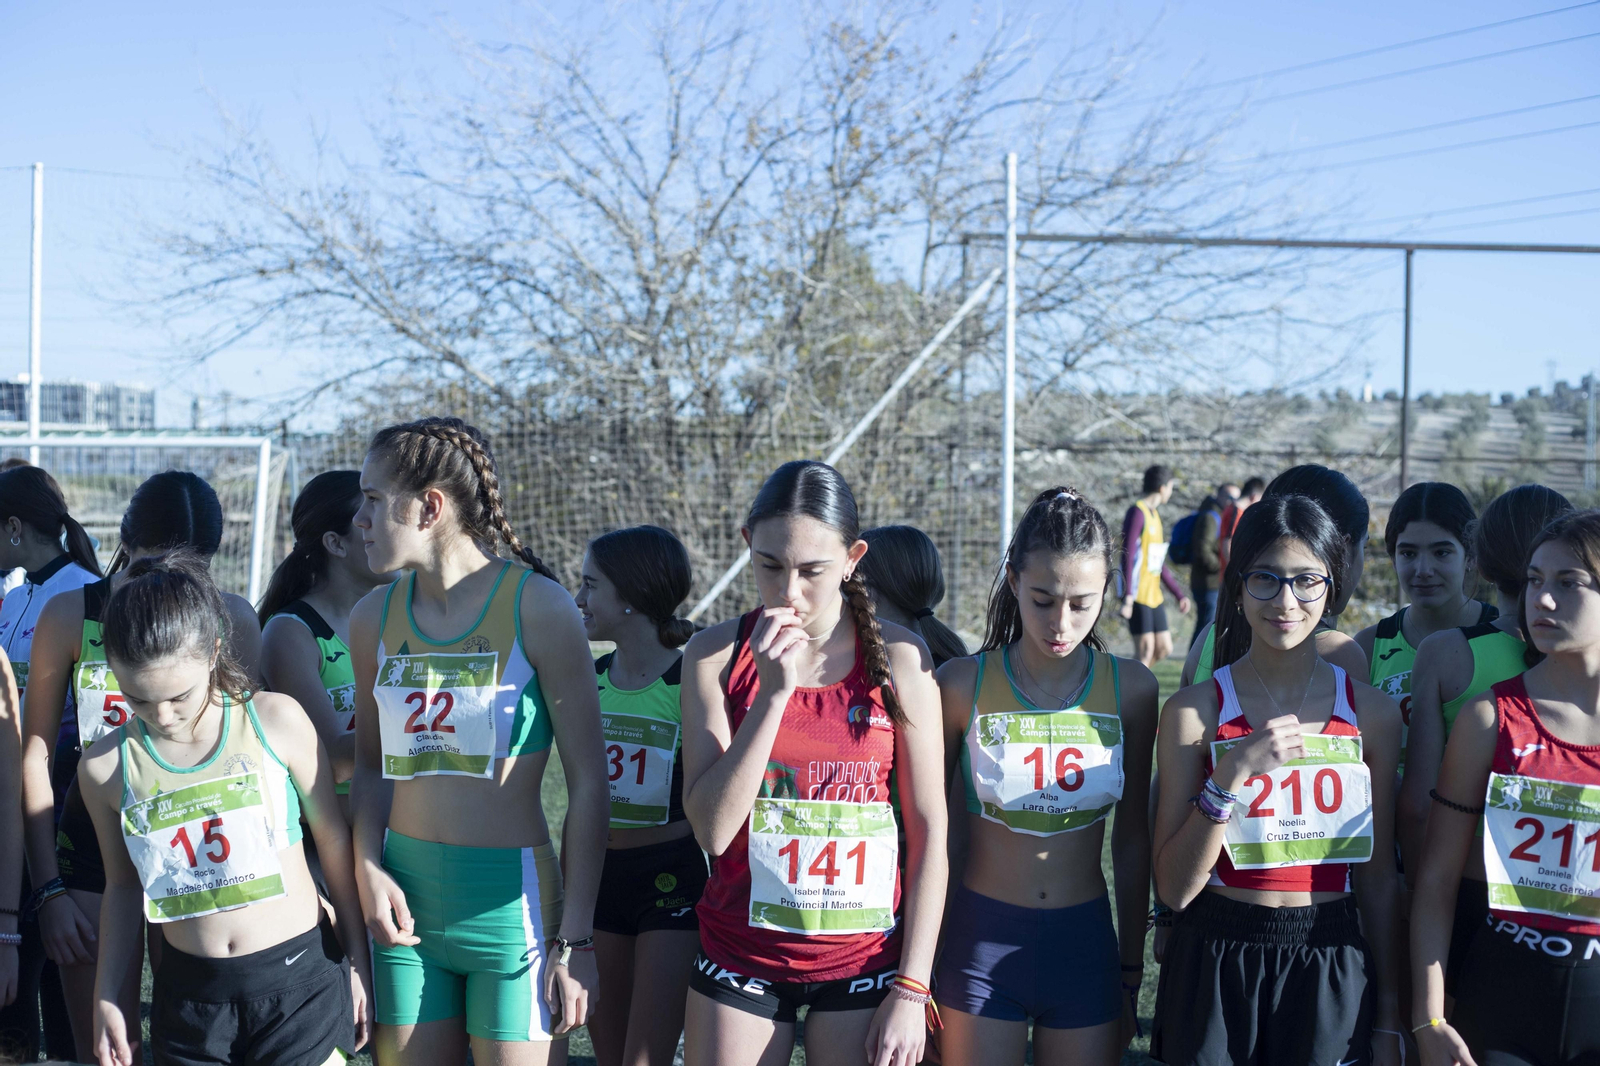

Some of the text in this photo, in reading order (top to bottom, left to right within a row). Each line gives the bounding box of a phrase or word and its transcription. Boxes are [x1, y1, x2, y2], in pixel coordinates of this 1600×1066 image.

[413, 662, 424, 674] XXV
[404, 692, 456, 734] 22
[1020, 718, 1036, 729] XXV
[1020, 729, 1050, 737] Campo
[1060, 728, 1086, 736] través
[808, 756, 880, 783] FUNDACIÓN
[1023, 747, 1085, 792] 16
[610, 795, 630, 803] opez
[1040, 792, 1059, 801] Alba
[1243, 768, 1343, 818] 210
[1535, 786, 1553, 800] XXV
[157, 799, 172, 814] XXV
[159, 808, 188, 820] Campo
[196, 799, 222, 810] través
[1022, 803, 1044, 812] Lara
[1534, 800, 1565, 811] Campo
[795, 808, 812, 820] XXV
[794, 820, 825, 829] Campo
[1278, 818, 1306, 827] Noelia
[1267, 831, 1325, 841] Cruz Bueno
[170, 817, 231, 868] 15
[1509, 817, 1600, 872] 211
[778, 838, 866, 885] 141
[1538, 867, 1572, 879] Daniela
[166, 873, 255, 896] Magdaleno Montoro
[795, 888, 820, 896] Isabel
[781, 898, 863, 909] Provincial Martos
[1496, 920, 1572, 957] PRO
[693, 953, 772, 995] NIKE
